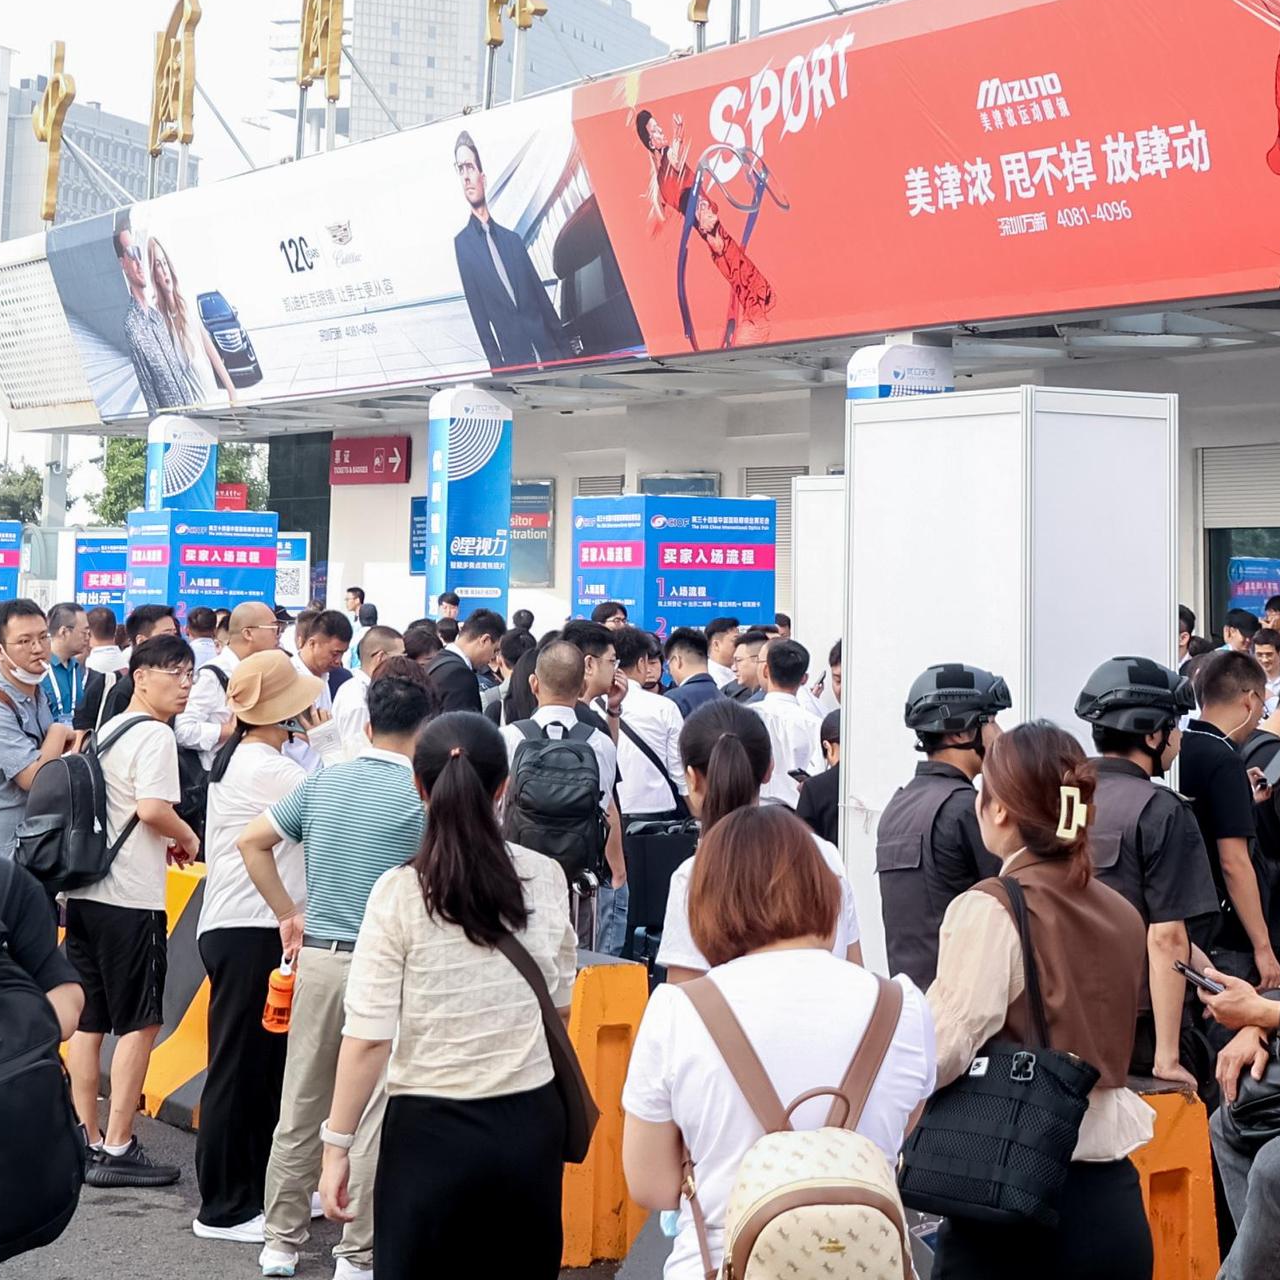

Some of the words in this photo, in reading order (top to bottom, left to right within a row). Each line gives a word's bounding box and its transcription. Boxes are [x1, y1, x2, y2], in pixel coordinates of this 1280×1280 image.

[709, 30, 855, 183] SPORT
[904, 157, 996, 217] 美津浓
[999, 139, 1097, 202] 甩不掉
[1101, 120, 1211, 185] 放肆动
[1056, 200, 1132, 227] 4081-4096
[185, 549, 260, 563] 买家入场流程
[664, 548, 755, 565] 买家入场流程
[76, 592, 126, 604] 请出示二
[670, 586, 707, 597] 入场流程
